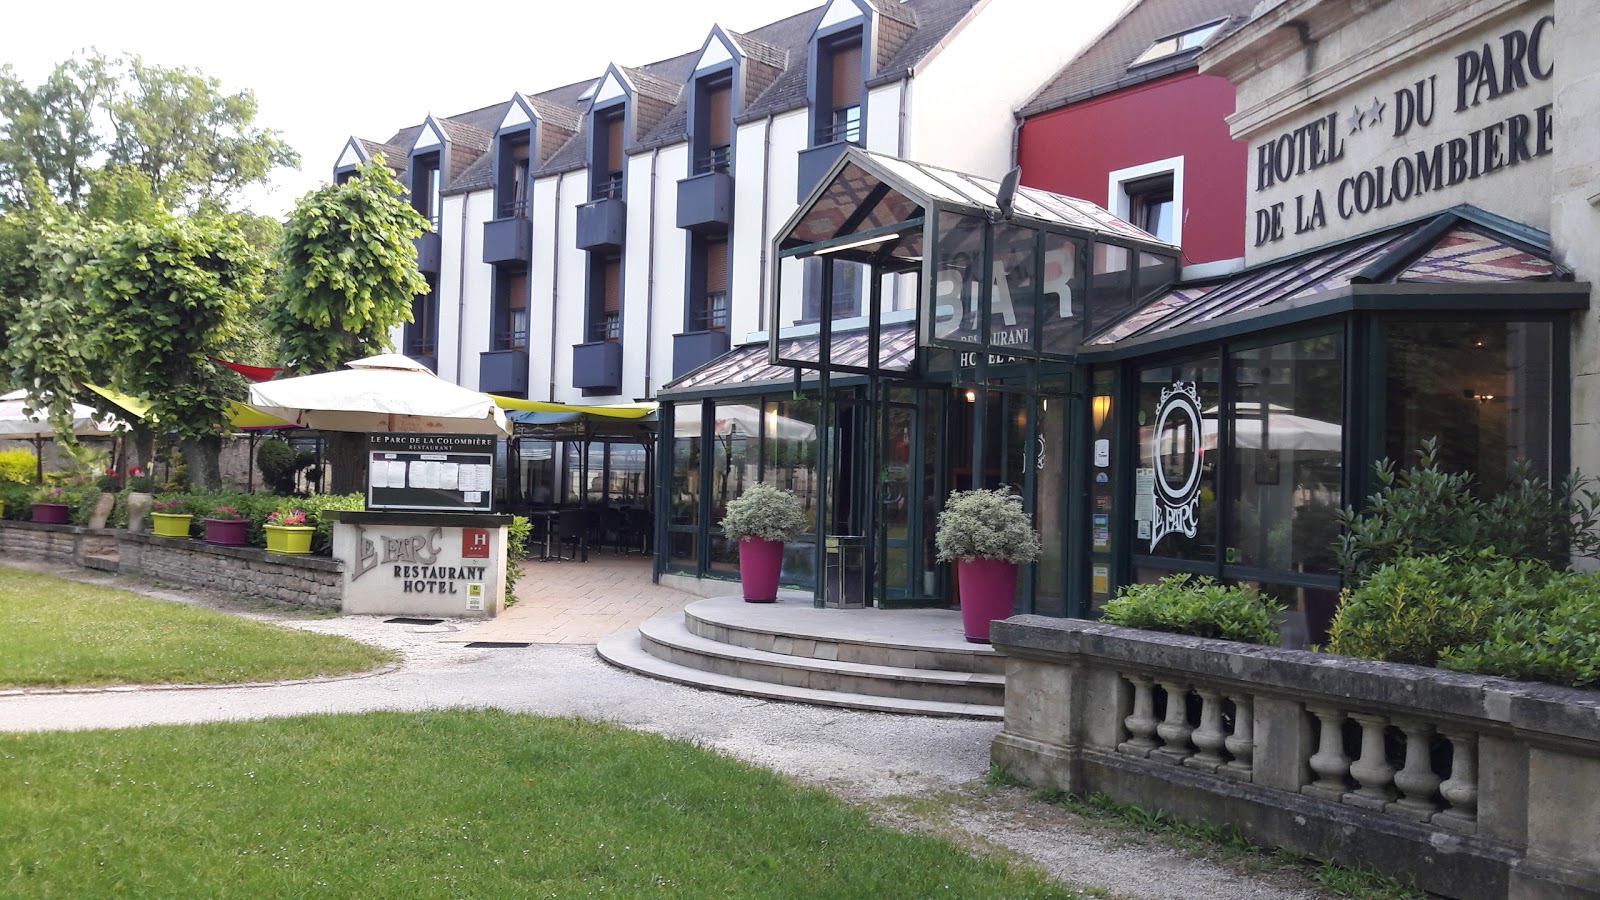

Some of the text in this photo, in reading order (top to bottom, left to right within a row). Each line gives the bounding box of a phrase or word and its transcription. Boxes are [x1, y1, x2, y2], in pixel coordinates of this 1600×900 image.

[1255, 15, 1555, 192] HOTEL DU PARC
[1254, 102, 1553, 247] DE LA COLOMBIERE
[935, 249, 1074, 339] BAR
[960, 352, 1004, 367] HOEL
[384, 436, 407, 444] PARC
[437, 437, 492, 446] COLOMBIÈRE
[1164, 490, 1201, 538] PARC
[381, 527, 443, 565] PARC
[474, 533, 486, 545] H
[394, 565, 486, 581] RESTAURANT
[403, 580, 457, 595] HOTEL
